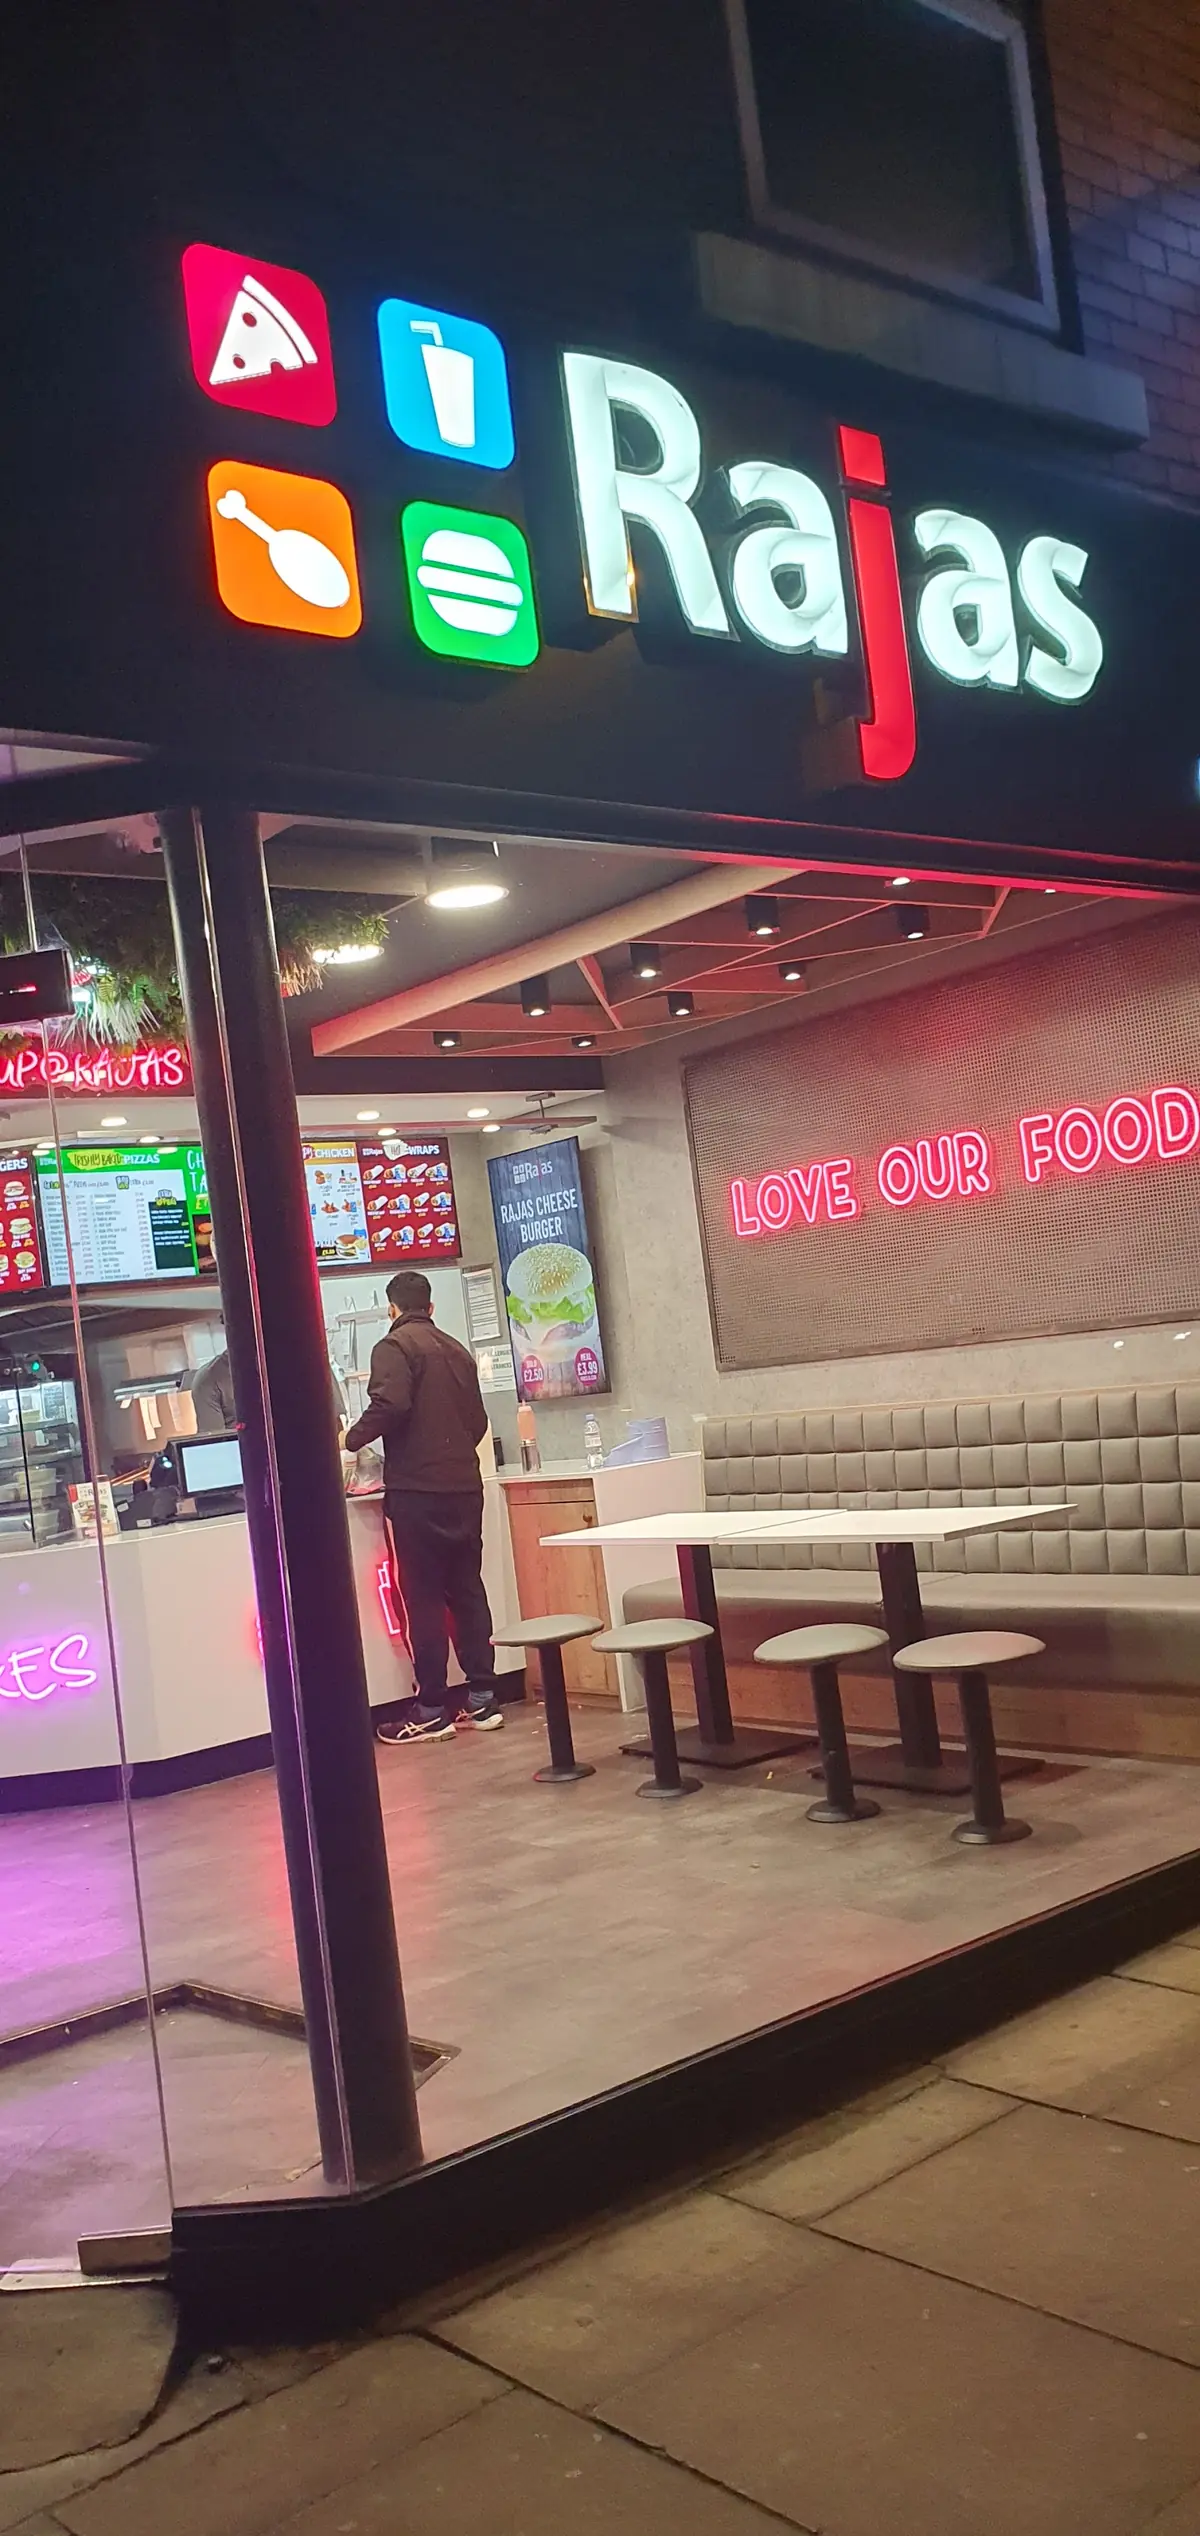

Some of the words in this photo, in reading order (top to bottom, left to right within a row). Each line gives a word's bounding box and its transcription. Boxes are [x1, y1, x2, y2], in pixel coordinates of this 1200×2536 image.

[561, 351, 1104, 779] Rajas
[315, 1147, 355, 1158] CHICKEN
[408, 1144, 440, 1156] WRAPS
[123, 1153, 160, 1165] PIZZAS
[731, 1159, 857, 1236] LOVE
[878, 1131, 991, 1206] OUR
[1019, 1086, 1200, 1183] FOOD
[501, 1200, 534, 1224] RAJAS
[536, 1188, 578, 1216] CHEESE
[520, 1216, 563, 1243] BURGER
[523, 1368, 543, 1382] £2.50
[577, 1361, 598, 1376] £3.99
